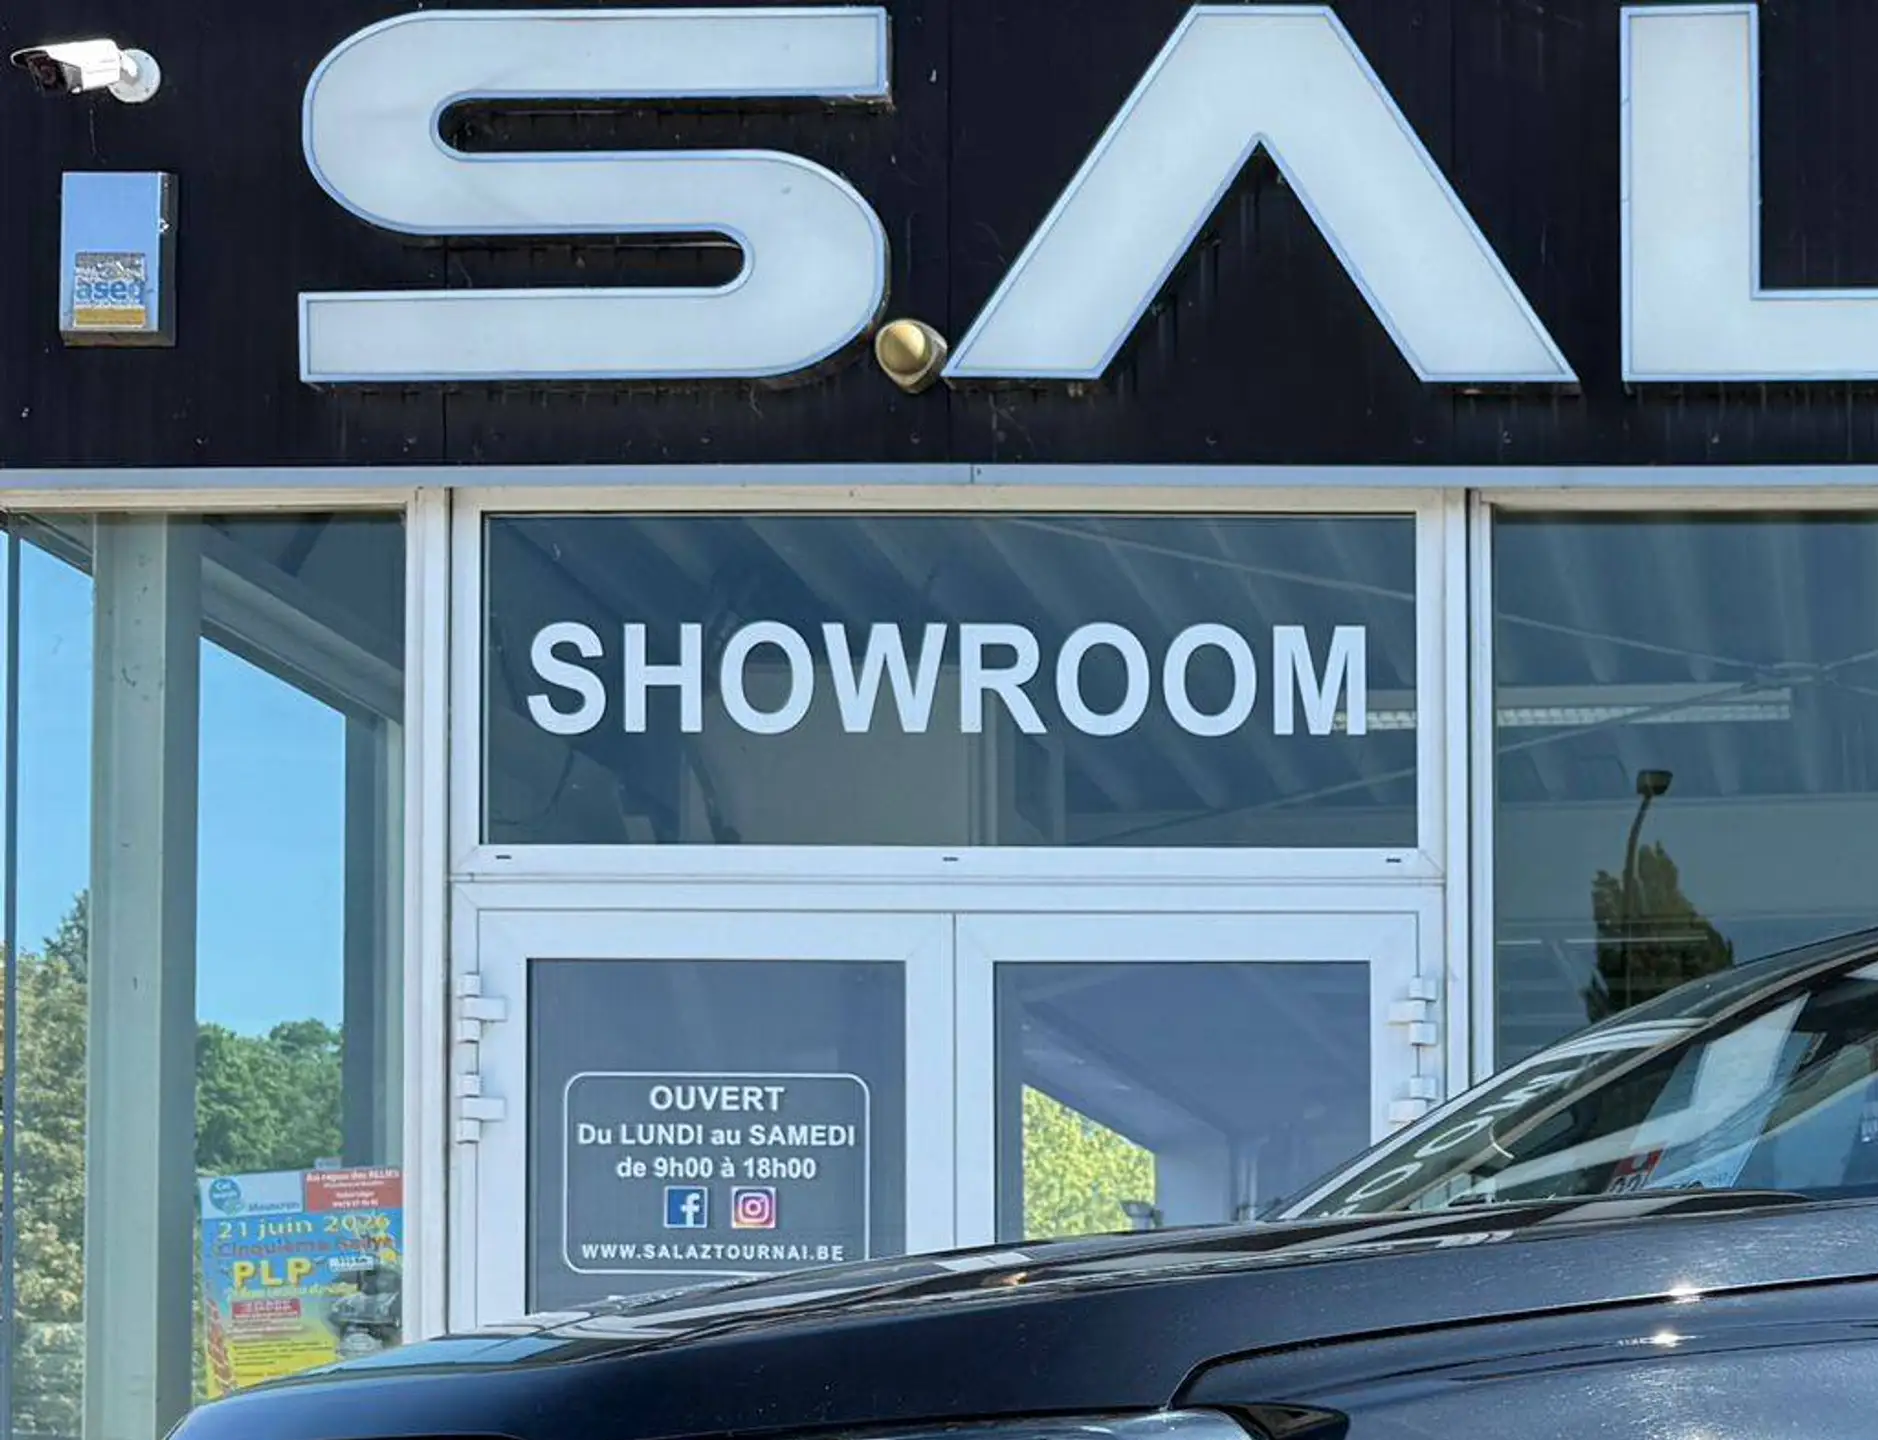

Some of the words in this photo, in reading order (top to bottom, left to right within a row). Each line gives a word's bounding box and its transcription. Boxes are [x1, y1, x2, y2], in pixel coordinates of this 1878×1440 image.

[525, 620, 1368, 737] SHOWROOM
[649, 1085, 785, 1111] OUVERT
[577, 1123, 612, 1145] Du
[620, 1123, 703, 1146] LUNDI
[711, 1127, 741, 1146] au
[749, 1124, 854, 1147] SAMEDI
[616, 1156, 647, 1178] de
[653, 1156, 713, 1179] 9h00
[720, 1156, 735, 1179] à
[743, 1157, 816, 1180] 18h00
[218, 1220, 248, 1239] 21
[258, 1217, 313, 1241] juin
[581, 1243, 844, 1262] WWW.SALAZTOURNAI.BE
[233, 1256, 314, 1291] PLP
